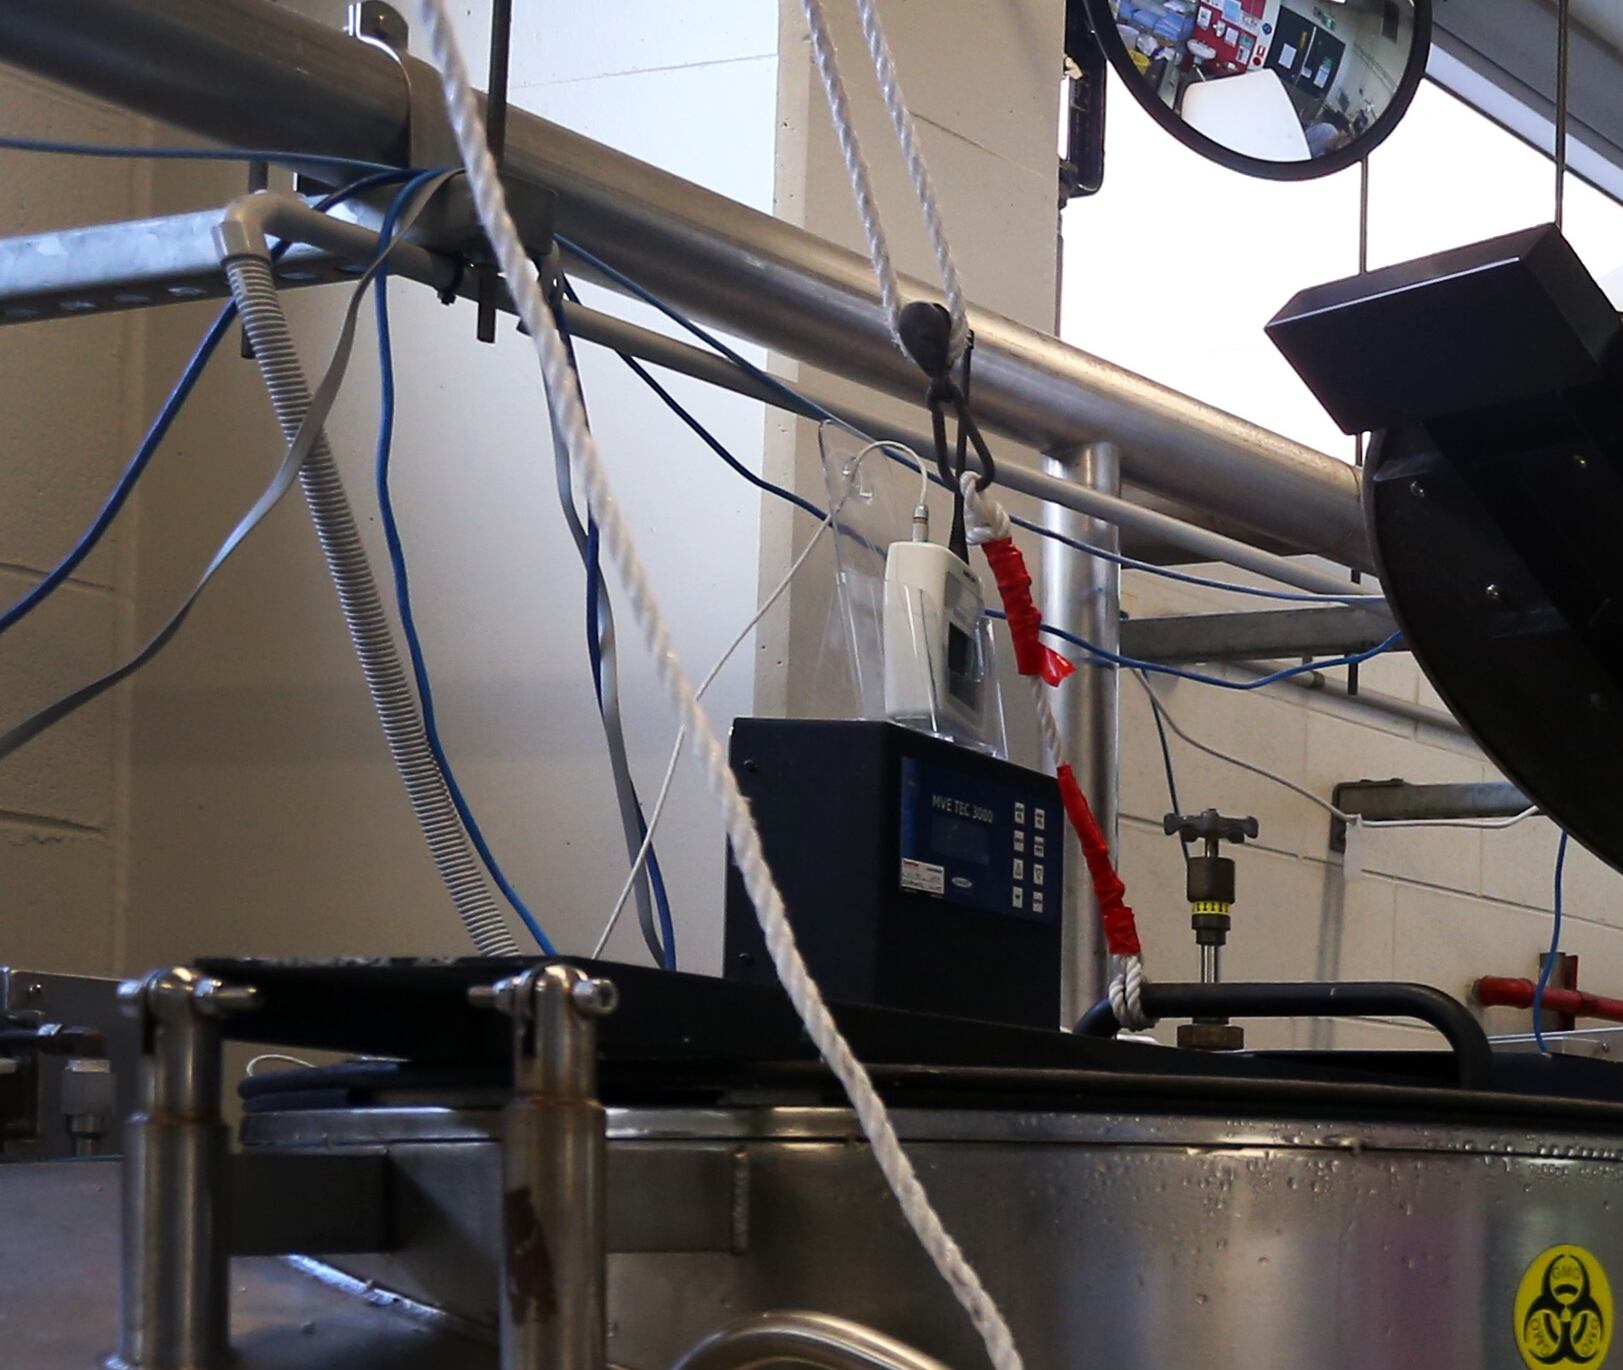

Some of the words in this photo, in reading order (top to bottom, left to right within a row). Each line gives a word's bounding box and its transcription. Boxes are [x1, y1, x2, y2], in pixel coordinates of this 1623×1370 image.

[931, 794, 952, 812] MVE
[954, 800, 971, 817] TEC
[972, 805, 994, 824] 3000
